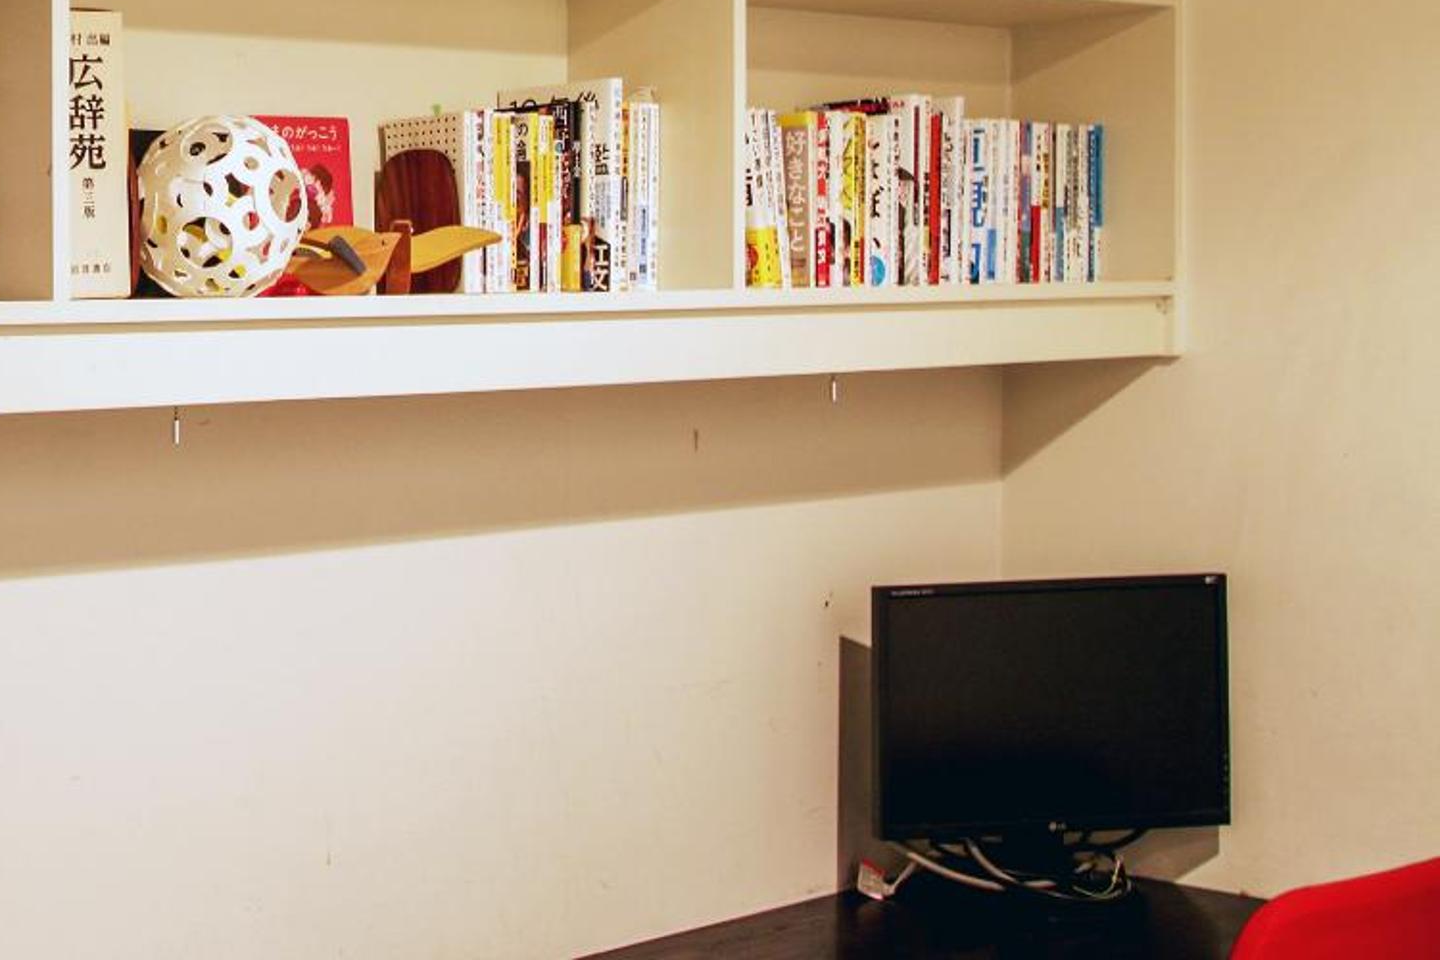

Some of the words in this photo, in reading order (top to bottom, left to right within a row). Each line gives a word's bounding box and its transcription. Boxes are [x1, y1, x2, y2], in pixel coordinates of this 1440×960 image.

[69, 53, 107, 171] 広辞苑
[785, 130, 806, 252] 好きなこと
